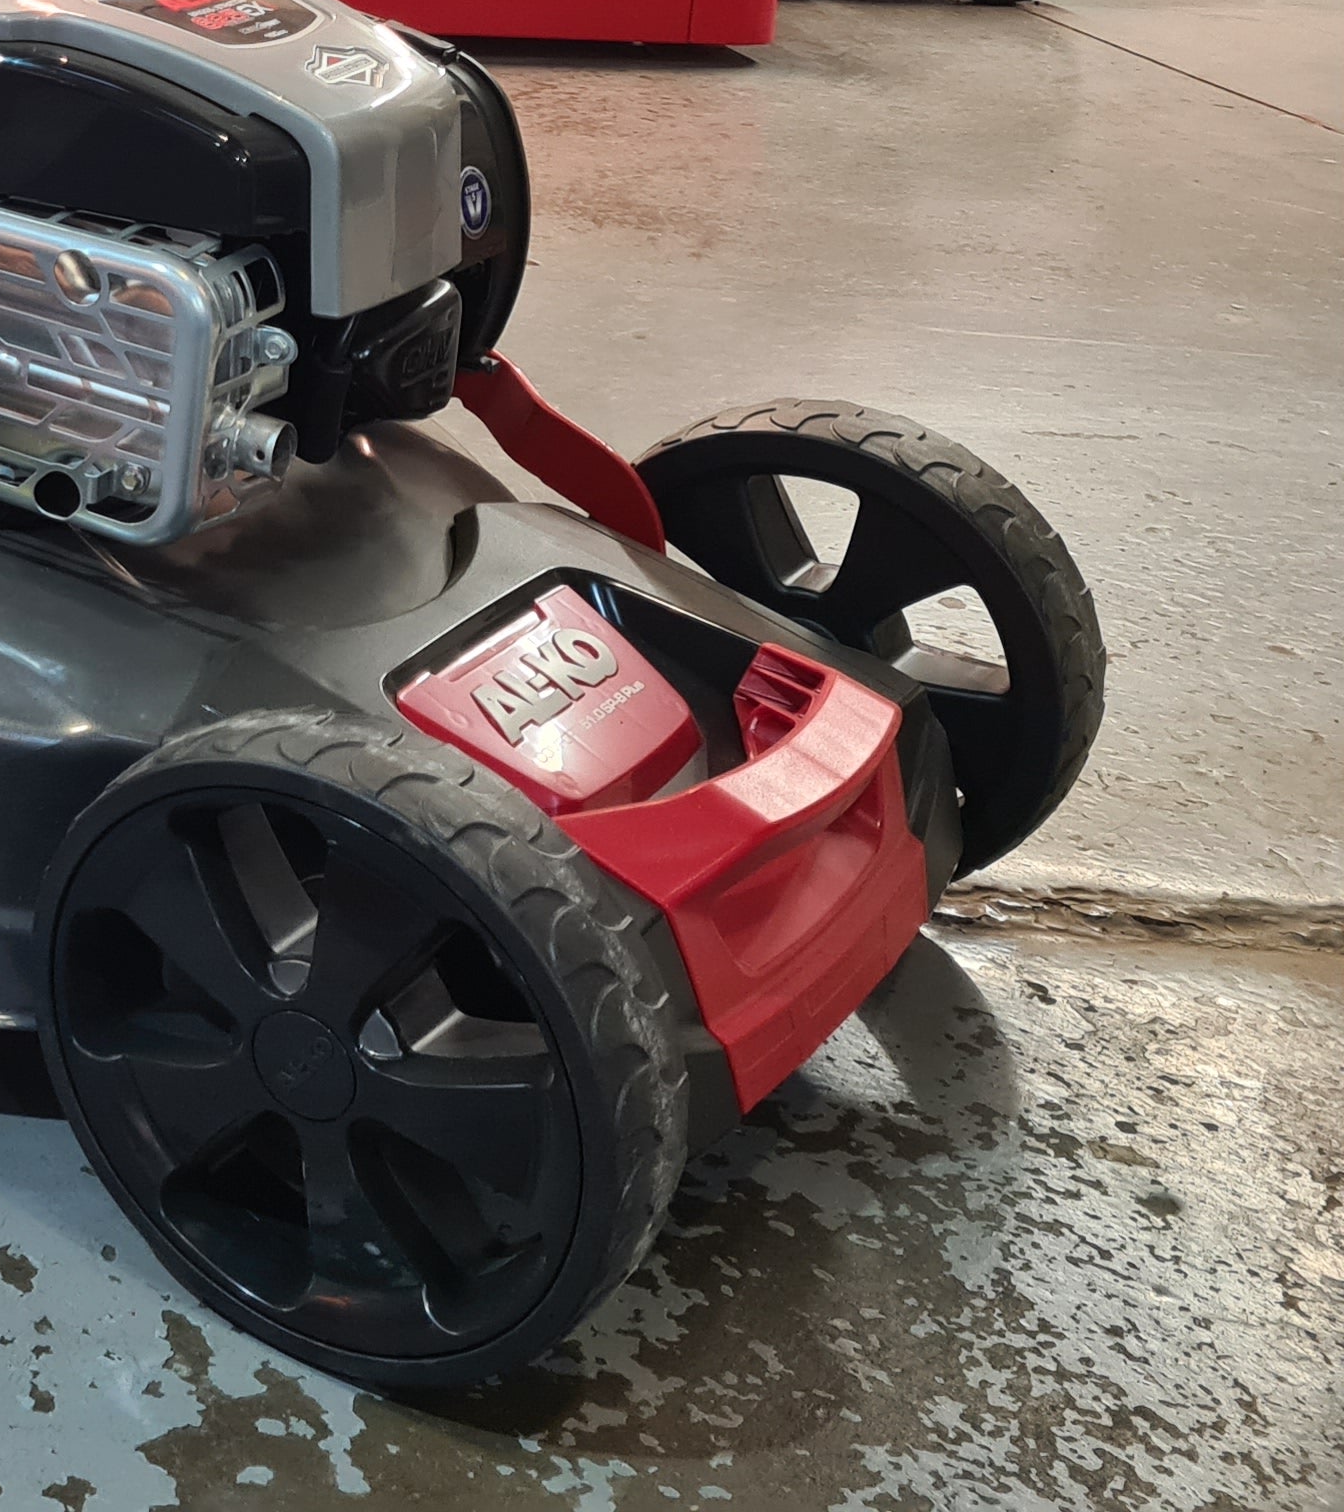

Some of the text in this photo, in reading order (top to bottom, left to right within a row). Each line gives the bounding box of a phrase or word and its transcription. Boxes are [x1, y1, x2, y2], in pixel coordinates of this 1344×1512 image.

[465, 182, 480, 195] STAGE
[470, 628, 620, 748] AL-KO
[580, 707, 606, 730] 51.0
